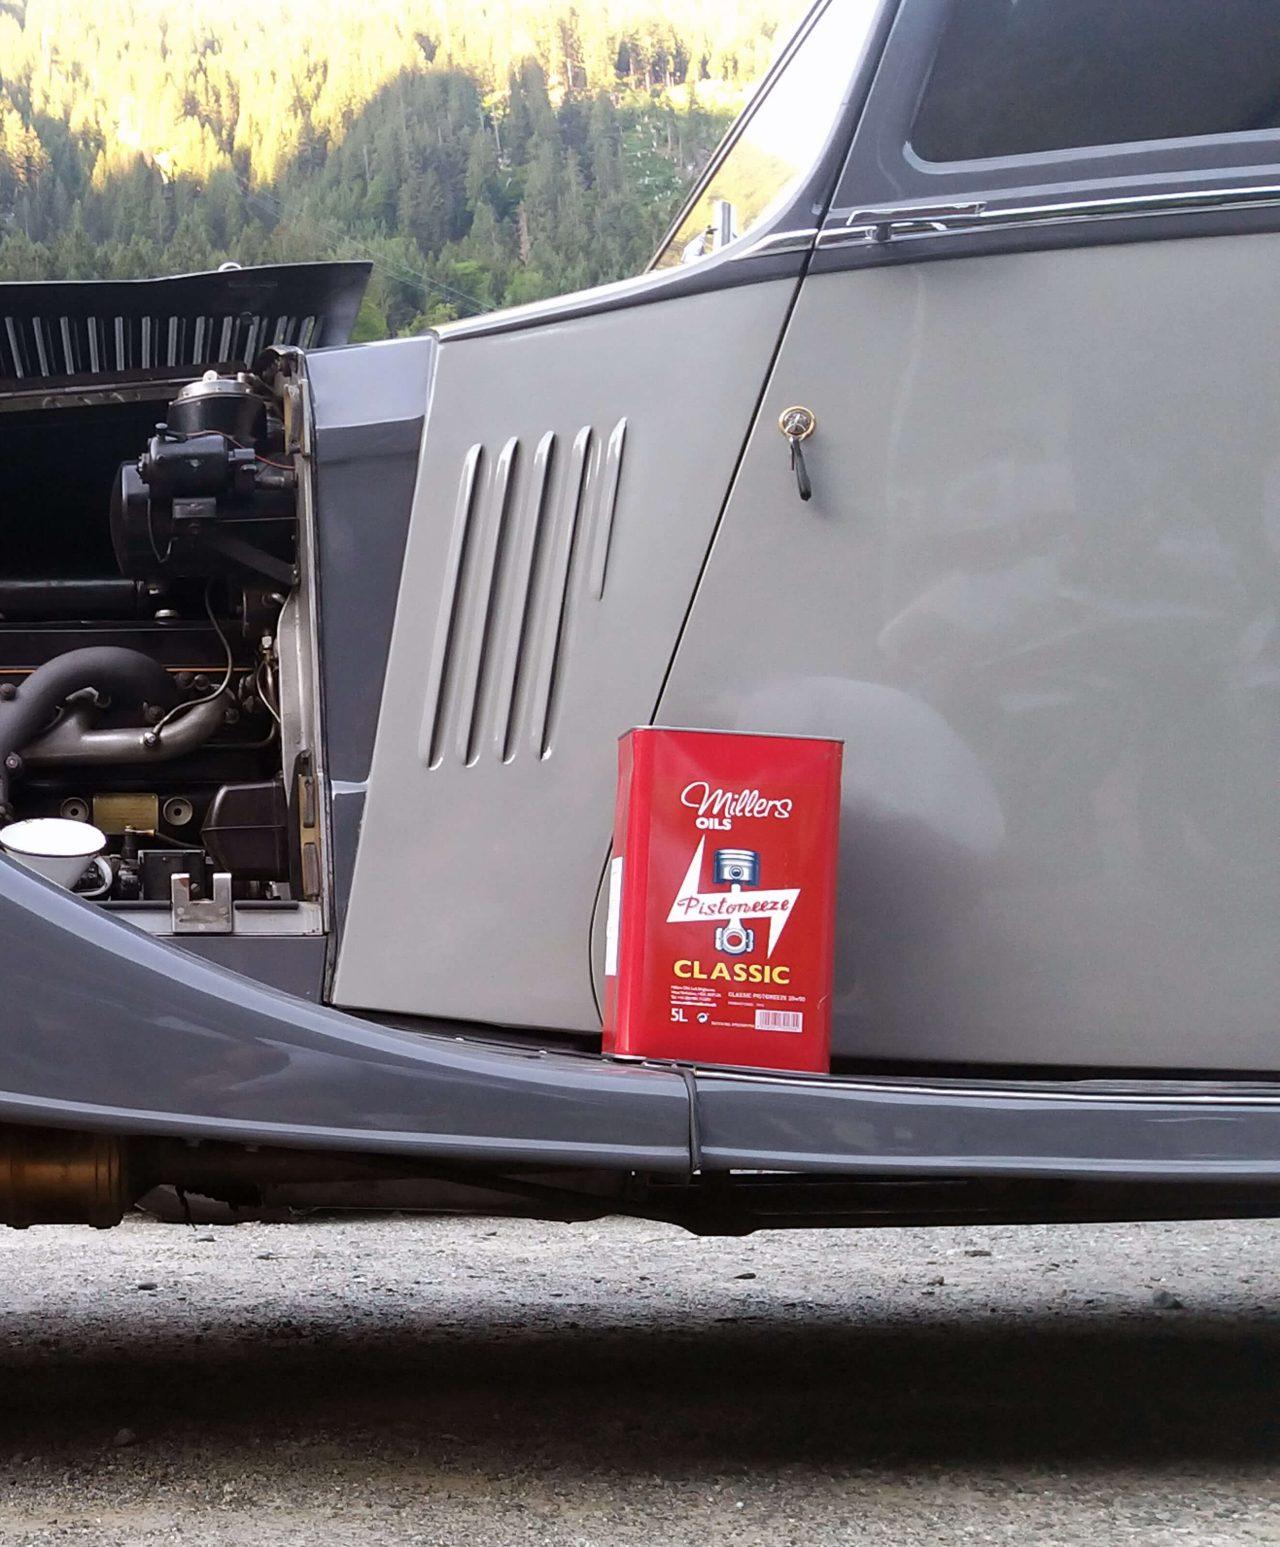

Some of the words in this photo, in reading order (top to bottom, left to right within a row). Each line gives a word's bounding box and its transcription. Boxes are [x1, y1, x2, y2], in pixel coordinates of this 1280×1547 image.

[680, 781, 793, 819] Millers
[695, 817, 733, 831] OILS
[677, 895, 790, 916] Pistoneeze
[673, 959, 790, 984] CLASSIC
[670, 1007, 689, 1023] 5L
